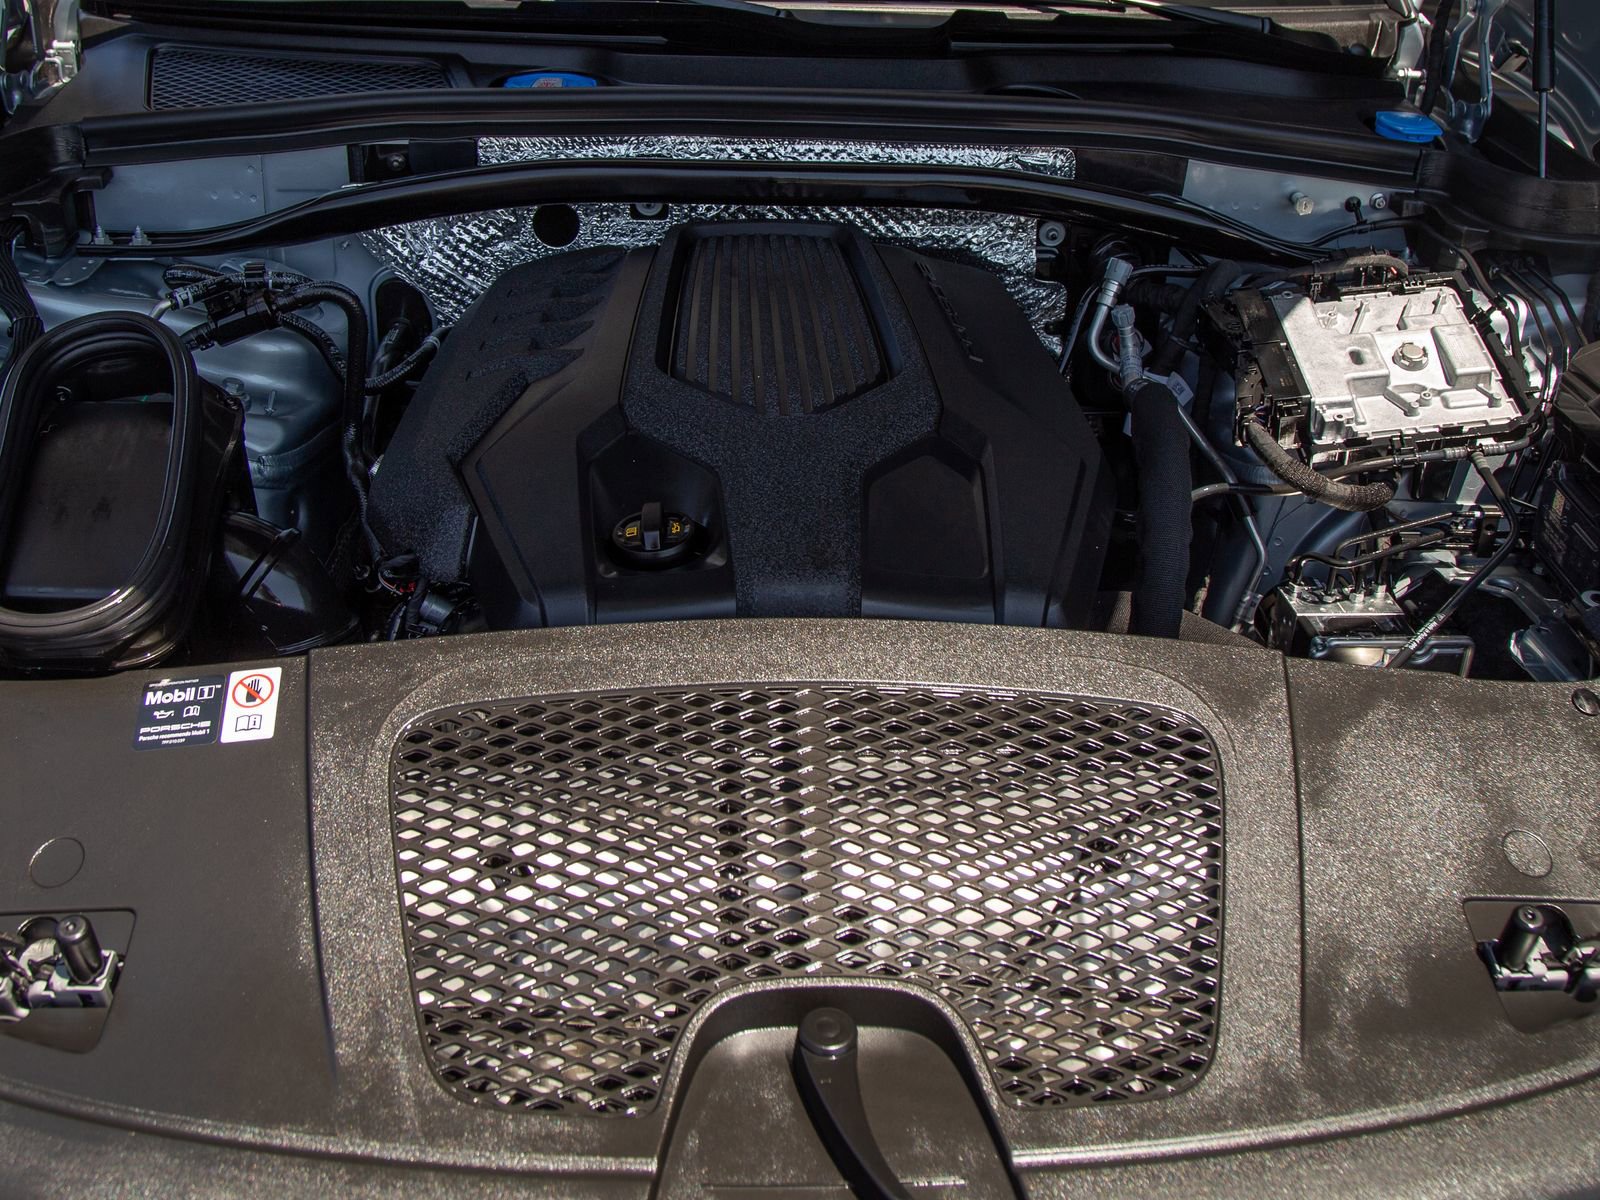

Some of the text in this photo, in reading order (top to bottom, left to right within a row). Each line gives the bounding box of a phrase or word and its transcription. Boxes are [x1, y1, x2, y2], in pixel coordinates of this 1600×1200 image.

[145, 685, 215, 705] Mobil 1
[140, 721, 211, 733] PORSCHE
